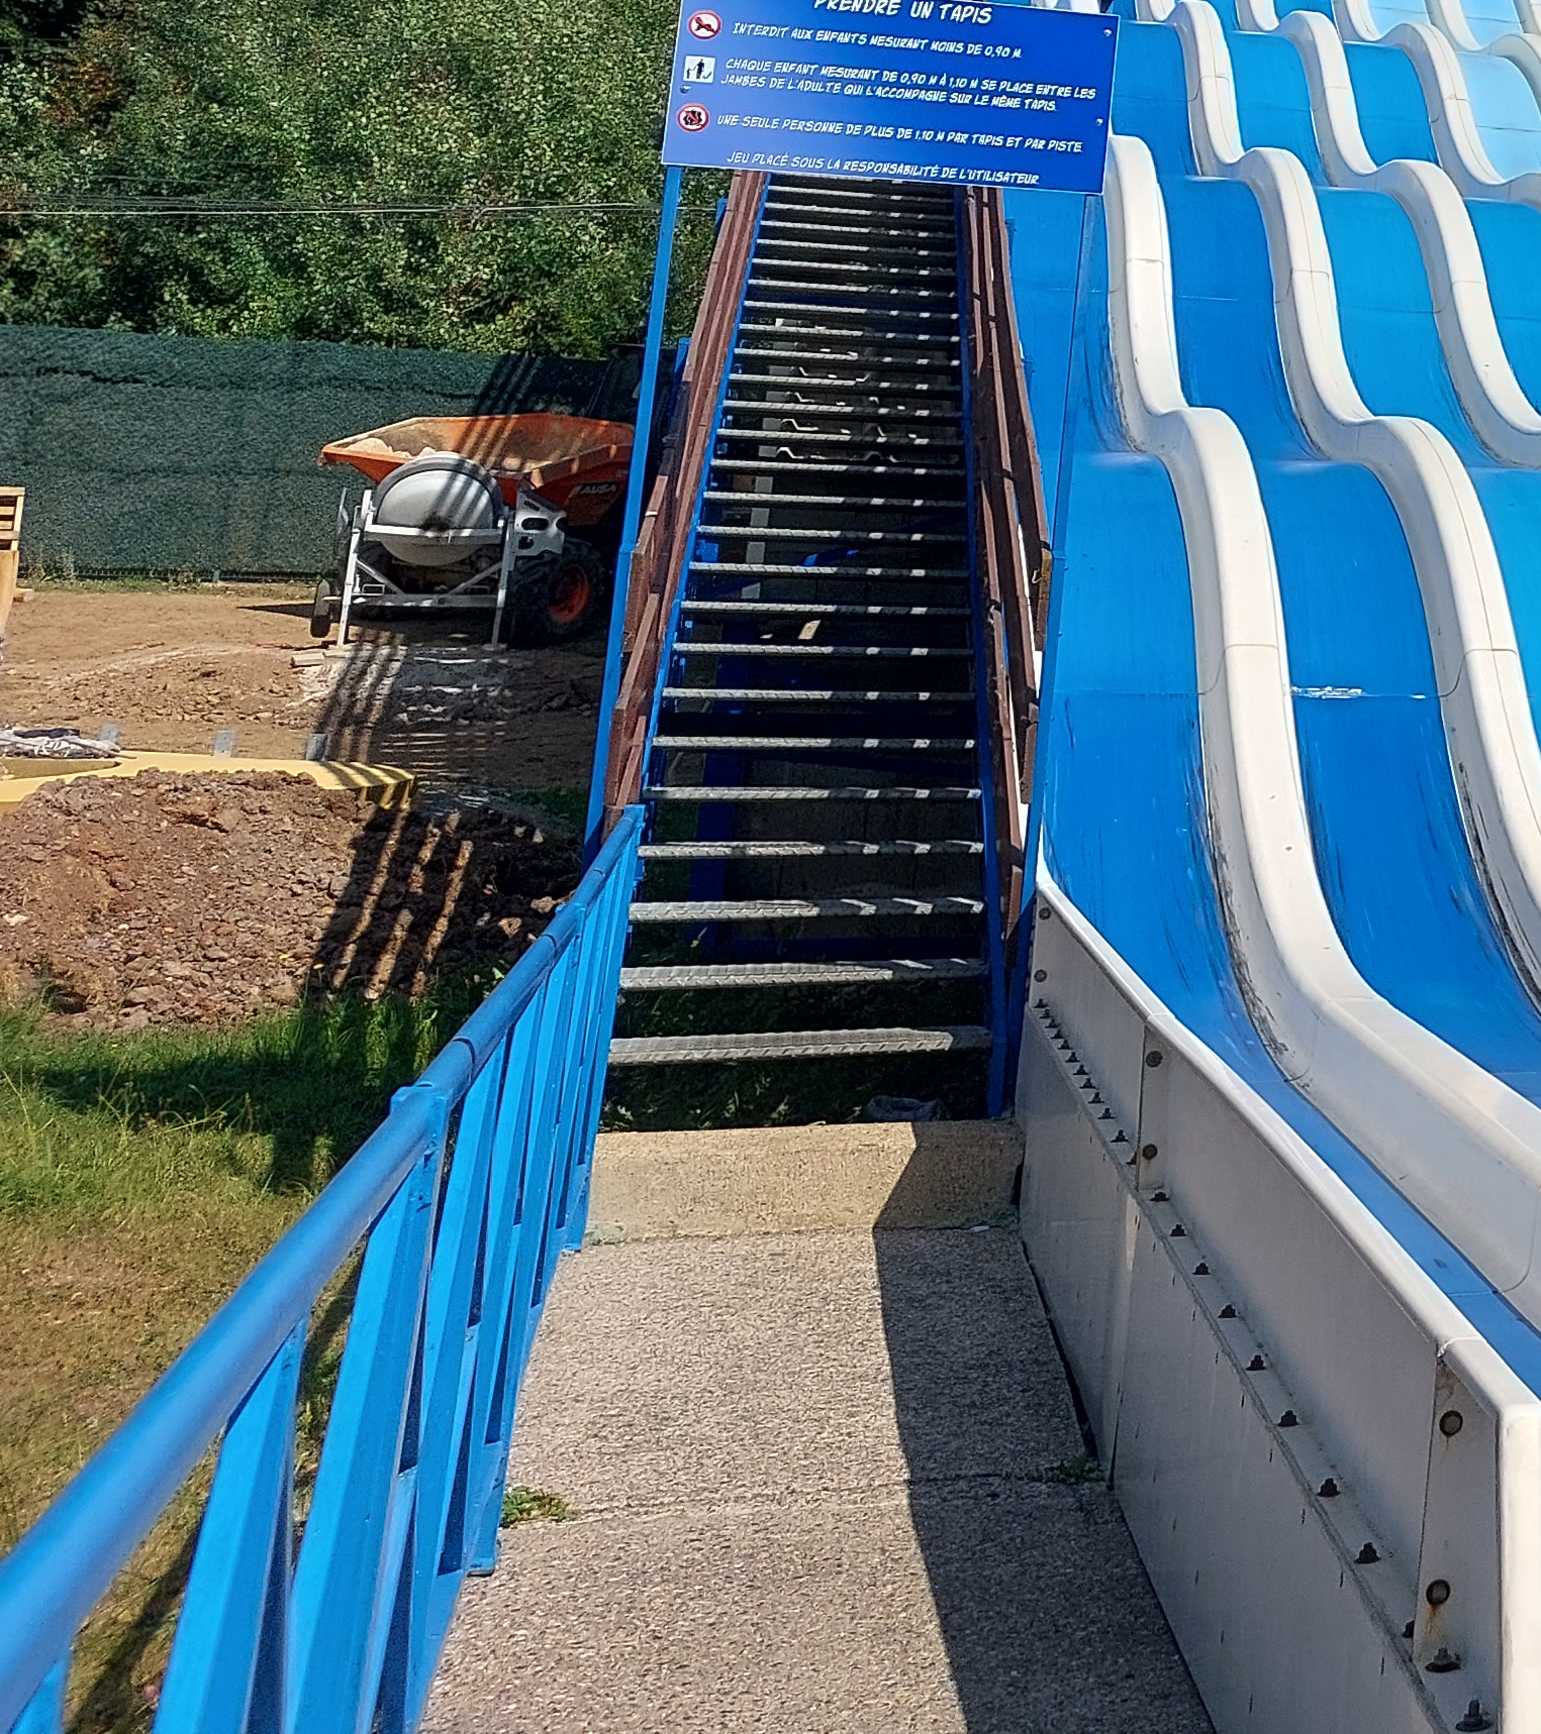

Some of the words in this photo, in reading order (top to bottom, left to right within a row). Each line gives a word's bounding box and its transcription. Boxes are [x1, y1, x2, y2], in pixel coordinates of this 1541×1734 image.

[910, 0, 935, 20] UN
[938, 3, 993, 24] TAPIS
[732, 21, 789, 38] INTERDIT
[790, 27, 814, 41] AUX
[815, 29, 868, 45] ENFANTS
[868, 35, 929, 51] MESURANT
[930, 40, 964, 54] MOINS
[966, 43, 983, 56] DE
[984, 45, 1010, 58] 0,90
[721, 73, 766, 87] JAMBES
[769, 77, 786, 89] DE
[787, 77, 841, 94] L'ADULTE
[843, 83, 864, 96] QUI
[865, 84, 948, 102] L'ACCOMPAGNE
[949, 92, 973, 105] SUR
[973, 94, 990, 107] LE
[990, 94, 1022, 108] MÊME
[725, 58, 772, 72] CHAQUE
[774, 61, 819, 75] ENFANT
[820, 66, 880, 82] MESURANT
[881, 70, 898, 83] DE
[899, 72, 927, 86] 0,90
[928, 74, 938, 86] M
[939, 72, 947, 86] À
[949, 76, 968, 89] 1,10
[969, 77, 979, 89] M
[980, 78, 997, 90] SE
[999, 80, 1034, 94] PLACE
[1035, 83, 1072, 98] ENTRE
[1073, 86, 1097, 101] LES
[717, 114, 740, 126] UNE
[741, 116, 780, 129] SEULE
[782, 118, 845, 134] PERSONNE
[845, 123, 862, 136] DE
[863, 124, 895, 139] PLUS
[896, 127, 913, 139] DE
[934, 130, 945, 142] M
[946, 131, 969, 144] PAR
[971, 133, 1004, 146] TAPIS
[1005, 136, 1023, 149] ET
[1024, 137, 1046, 150] PAR
[726, 150, 750, 164] JEU
[751, 151, 789, 165] PLACÉ
[790, 156, 825, 169] SOUS
[827, 158, 841, 171] LA
[842, 160, 940, 177] RESPONSABILITÉ
[940, 167, 958, 179] DE
[580, 483, 616, 494] AUSA
